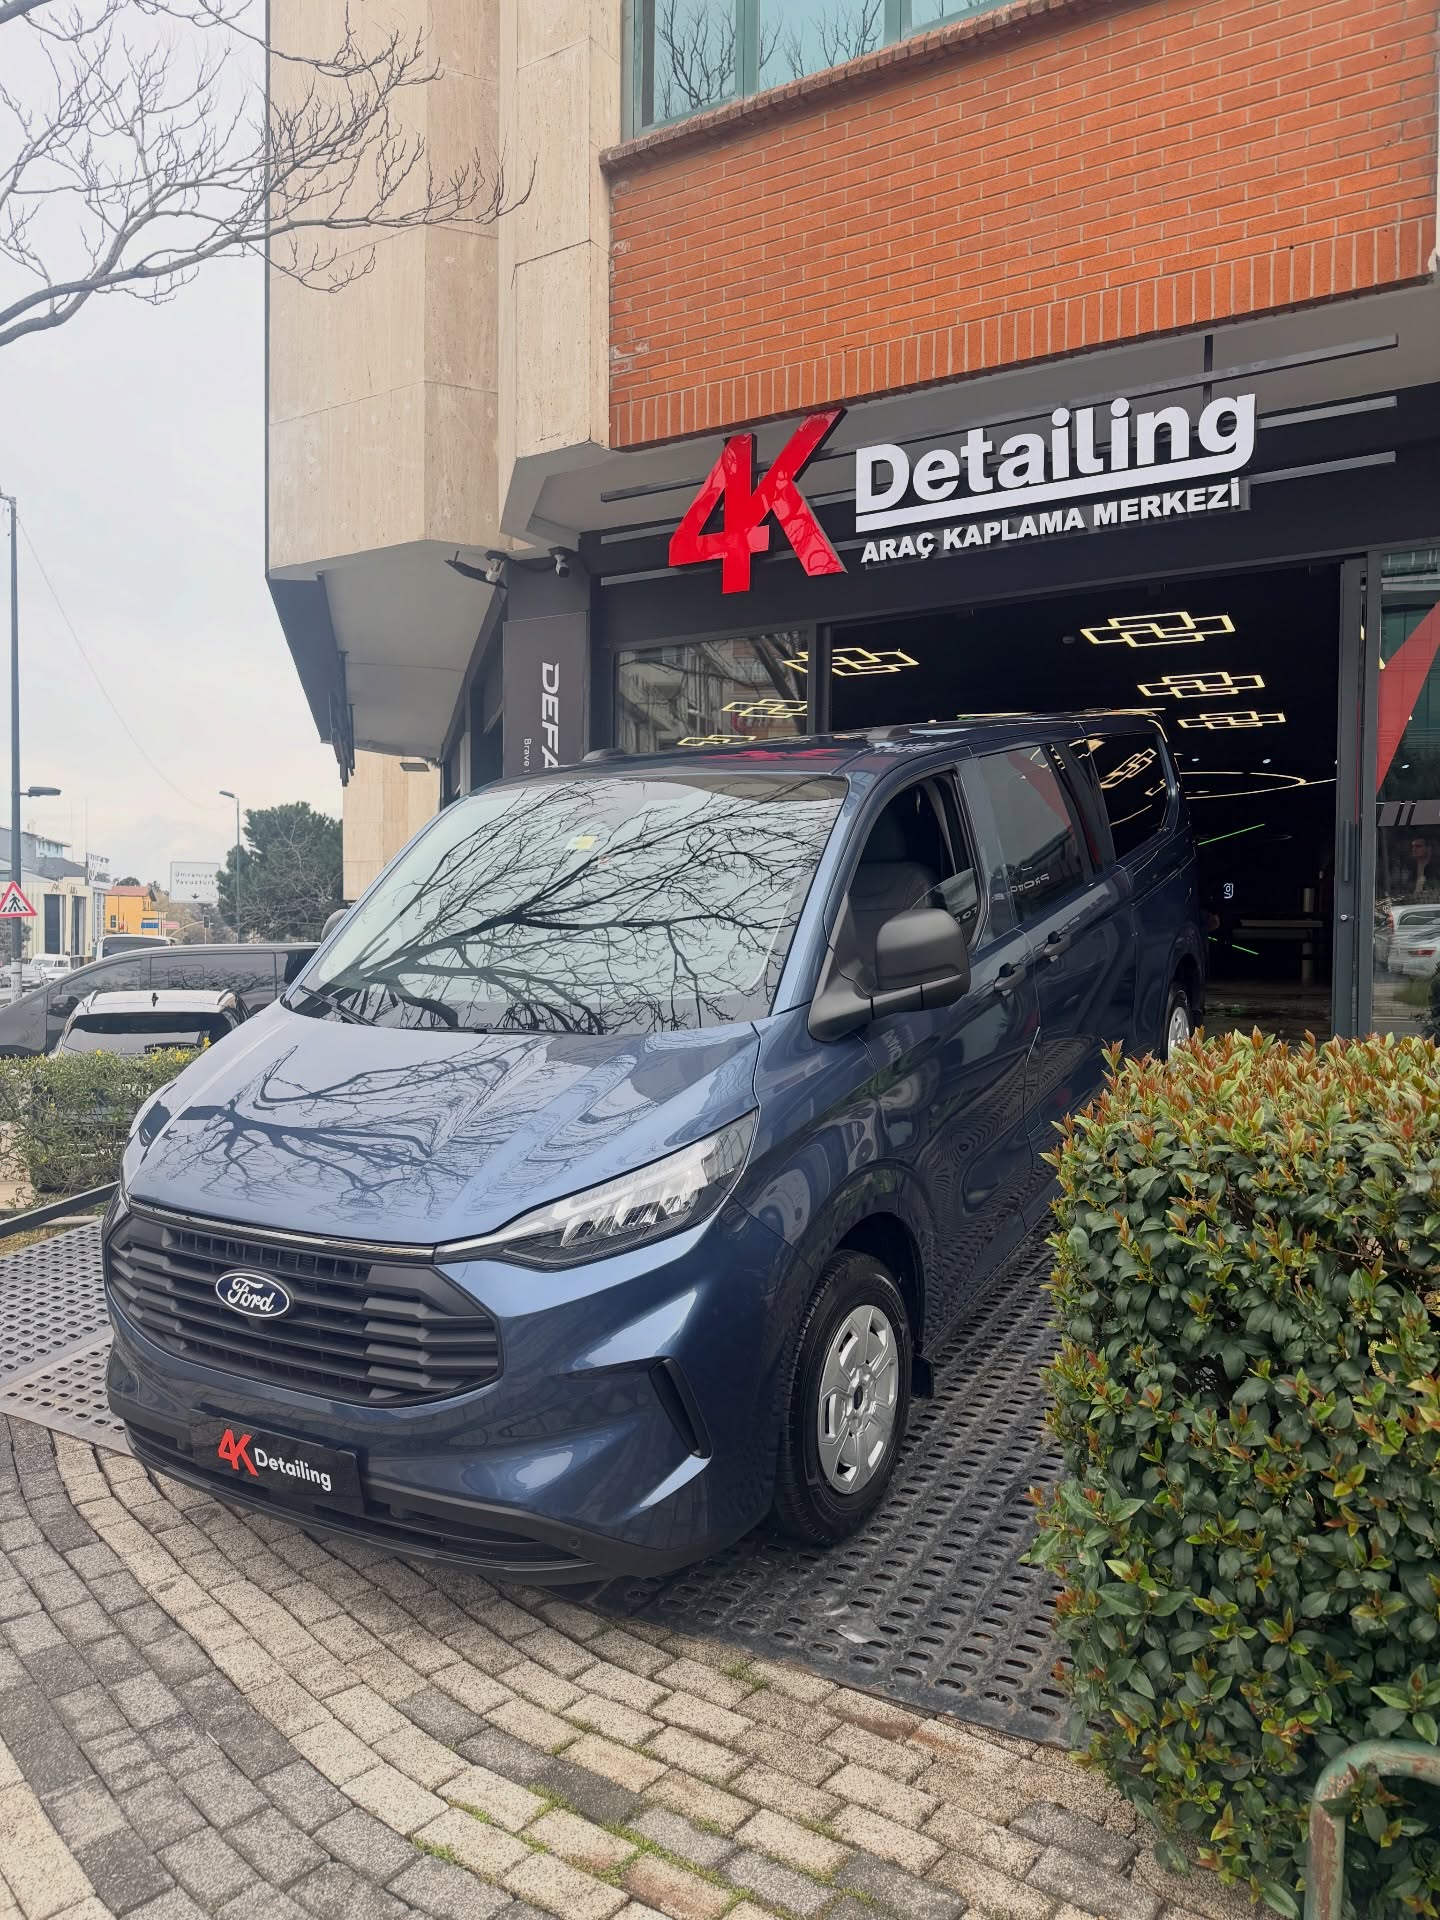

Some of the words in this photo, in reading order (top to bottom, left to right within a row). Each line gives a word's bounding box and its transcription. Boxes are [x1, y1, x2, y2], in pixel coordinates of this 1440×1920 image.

[668, 408, 847, 594] 4K
[855, 392, 1257, 533] Detailing
[862, 533, 935, 565] ARAÇ
[943, 510, 1085, 551] KAPLAMA
[1092, 477, 1242, 526] MERKEZİ
[523, 738, 532, 767] Brave
[227, 1277, 275, 1313] Ford
[217, 1428, 259, 1477] 4K
[254, 1447, 332, 1492] Detailing
